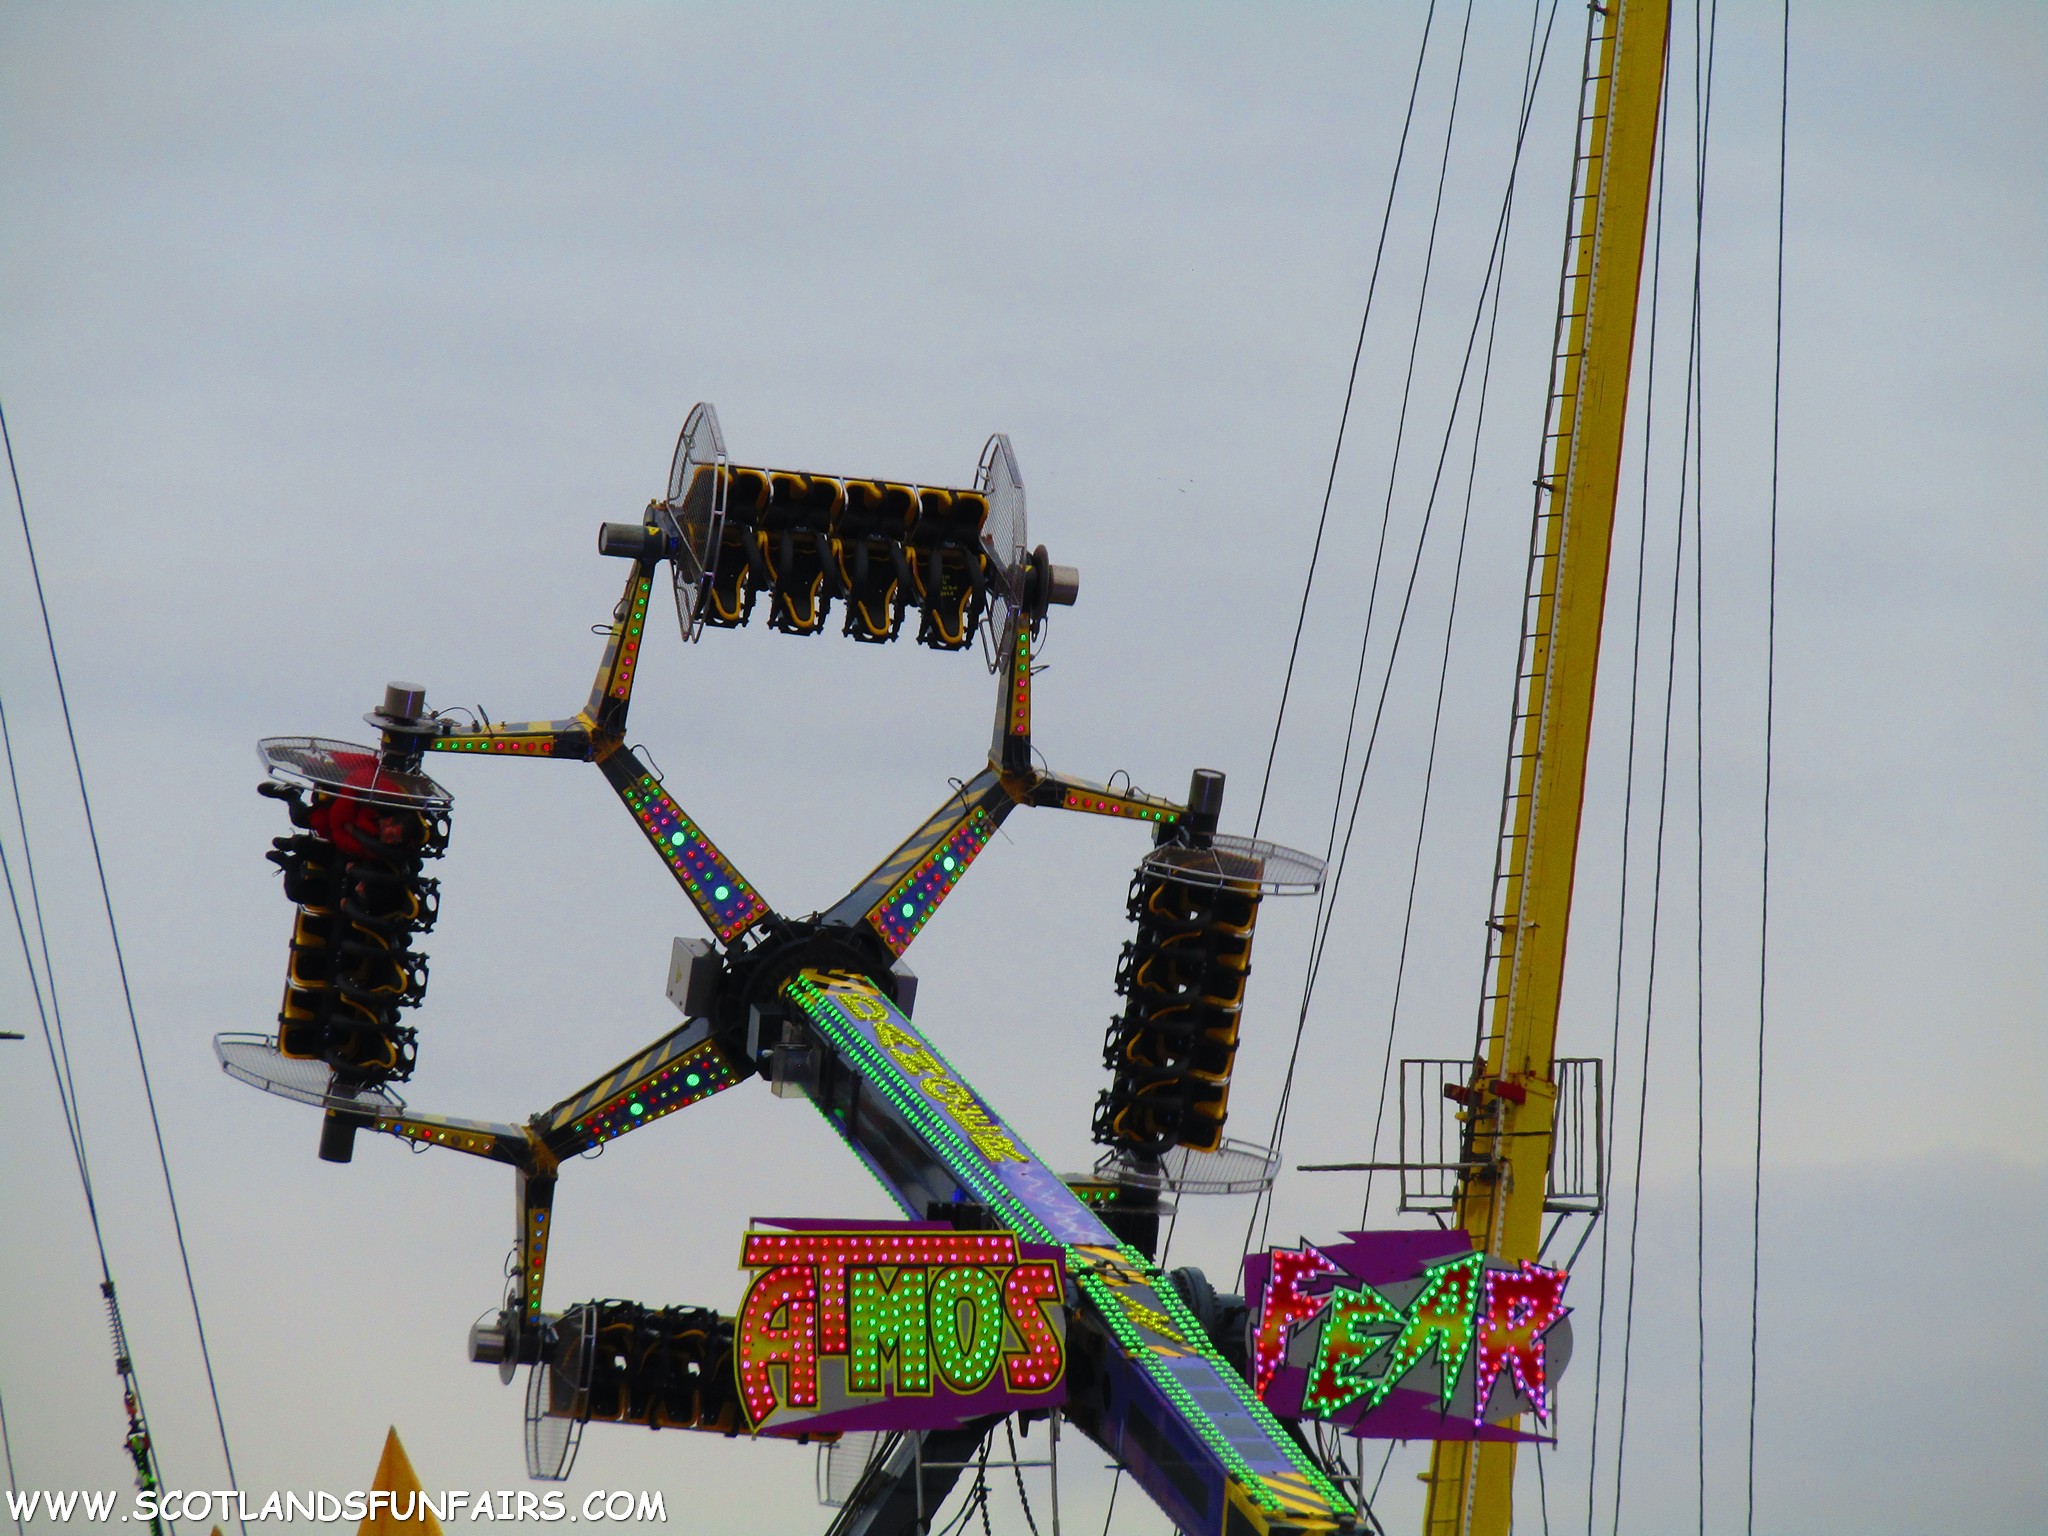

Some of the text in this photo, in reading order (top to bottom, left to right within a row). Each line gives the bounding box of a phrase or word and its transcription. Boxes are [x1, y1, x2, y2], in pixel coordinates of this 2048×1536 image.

[837, 993, 1030, 1163] DANGER
[736, 1232, 1066, 1432] ATMOS
[1253, 1238, 1574, 1437] FEAR
